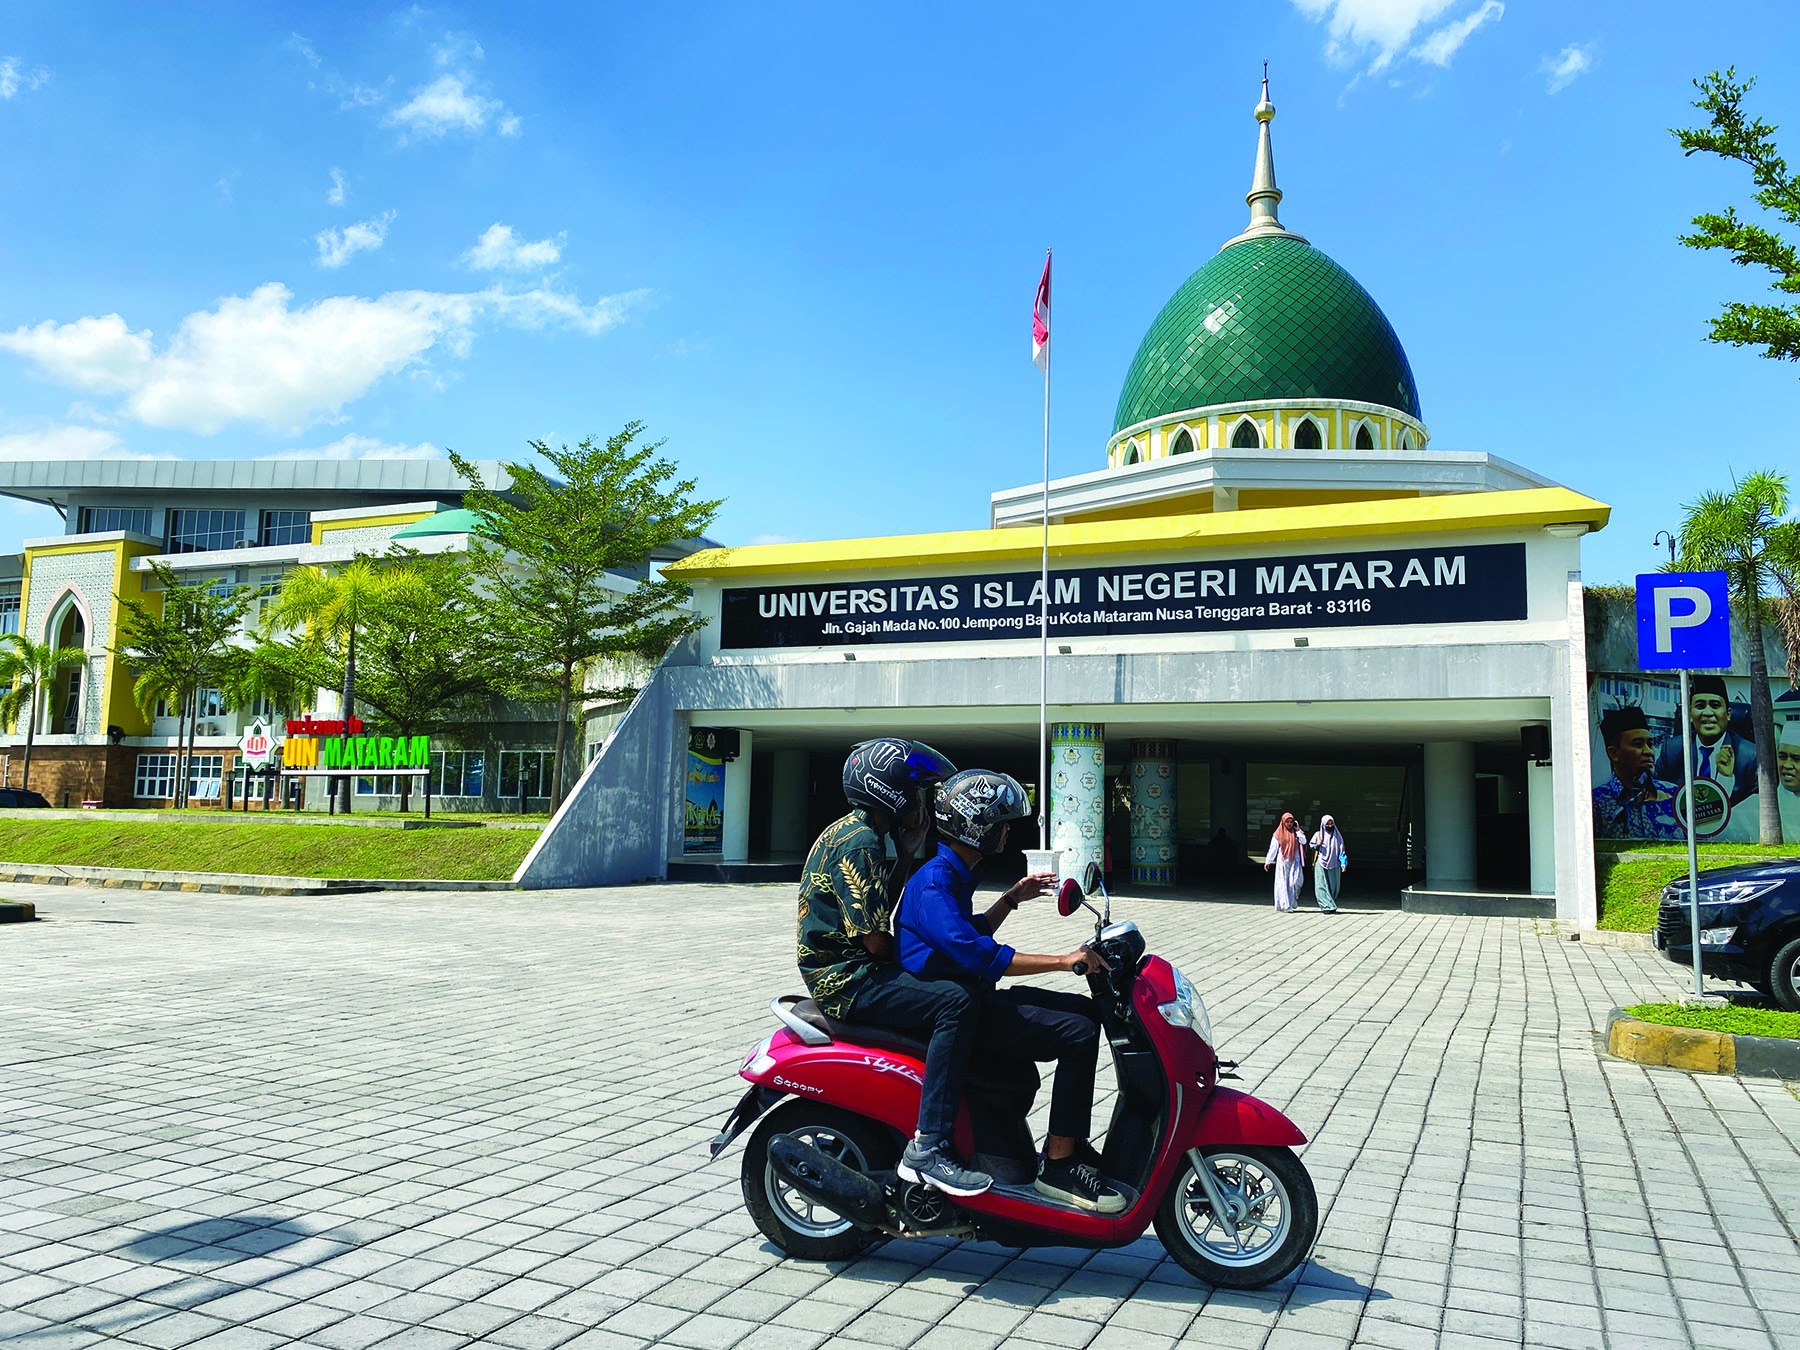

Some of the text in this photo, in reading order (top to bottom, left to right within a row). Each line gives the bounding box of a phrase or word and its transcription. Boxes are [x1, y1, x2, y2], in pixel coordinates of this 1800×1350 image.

[759, 556, 1466, 617] UNIVERSITAS ISLAM NEGERI MATARAM
[821, 622, 844, 634] Jln.
[844, 620, 881, 636] Gajah
[882, 619, 917, 632] Mada
[918, 617, 961, 631] No.100
[961, 616, 1024, 631] Jempong
[1059, 611, 1092, 625] Kota
[1093, 609, 1154, 624] Mataram
[1155, 607, 1194, 621] Nusa
[1194, 605, 1265, 622] Tenggara
[1268, 601, 1313, 617] Barat
[1326, 598, 1372, 614] 83116
[1653, 586, 1712, 653] P
[286, 714, 364, 735] welcome to
[282, 735, 431, 767] UIN MATARAM
[867, 778, 898, 801] MONSTER
[1695, 803, 1713, 811] ANTRI
[864, 1056, 924, 1086] Stylis
